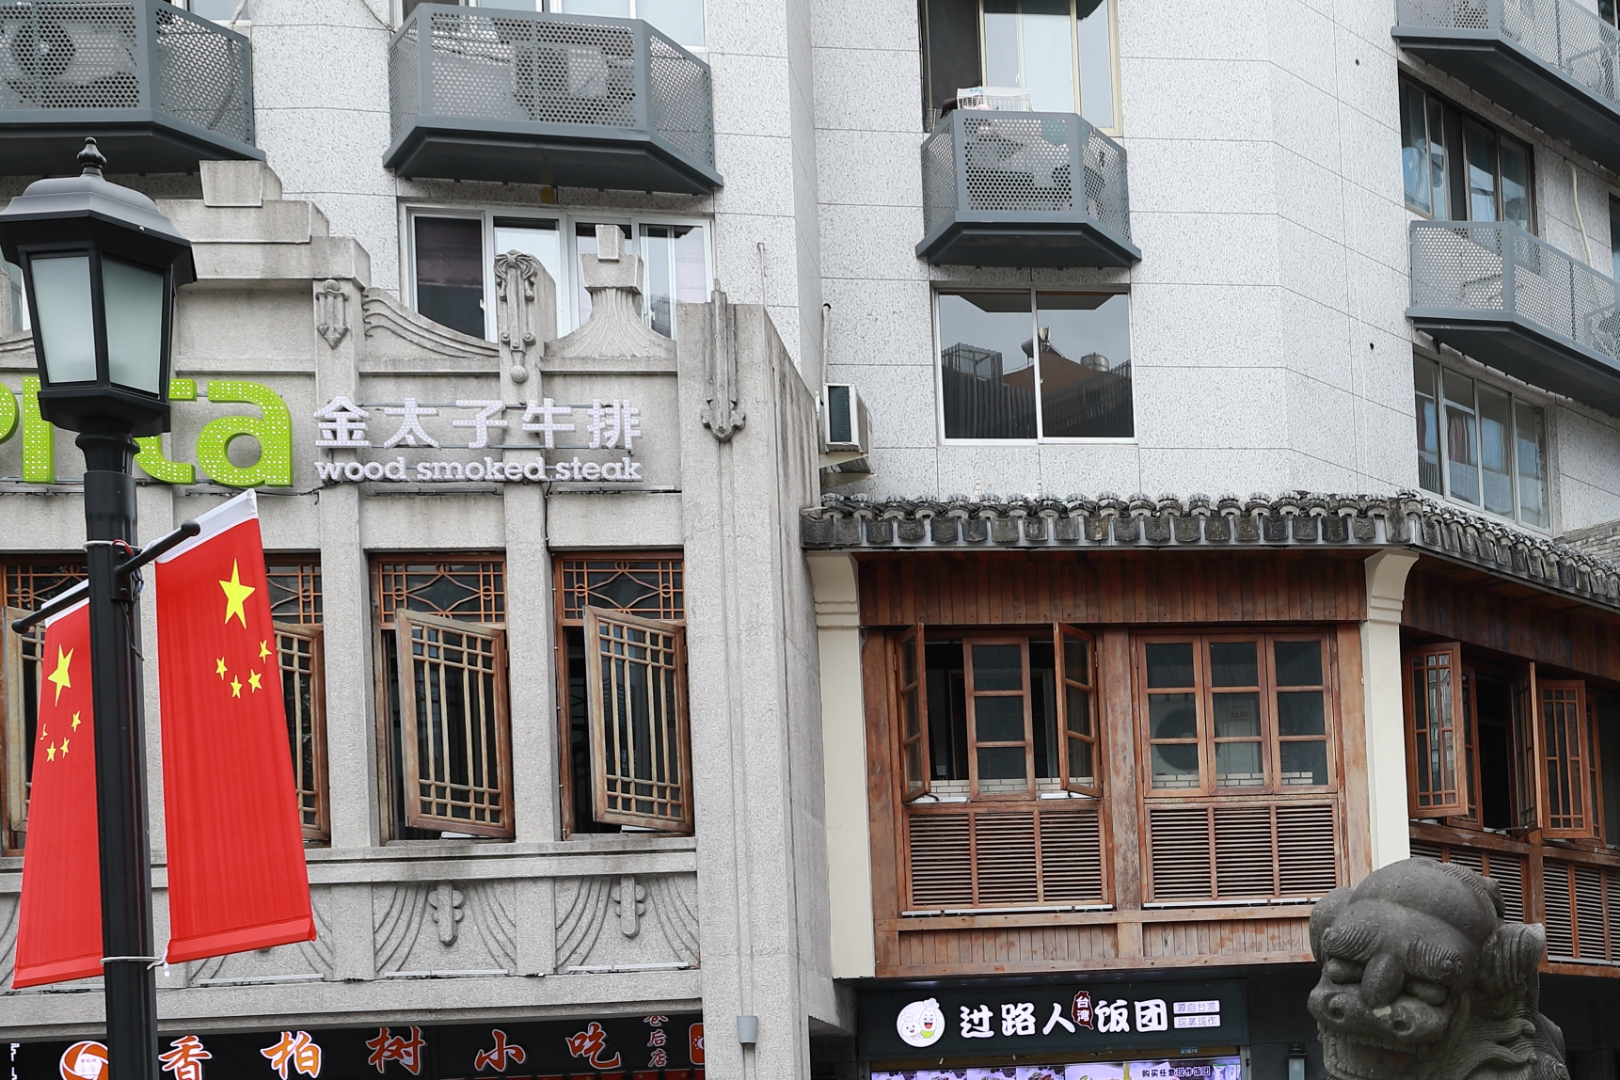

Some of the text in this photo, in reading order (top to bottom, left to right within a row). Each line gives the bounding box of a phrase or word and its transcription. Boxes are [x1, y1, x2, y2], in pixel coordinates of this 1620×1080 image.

[314, 396, 642, 450] 金太子牛排
[314, 456, 644, 482] wood smoked steak
